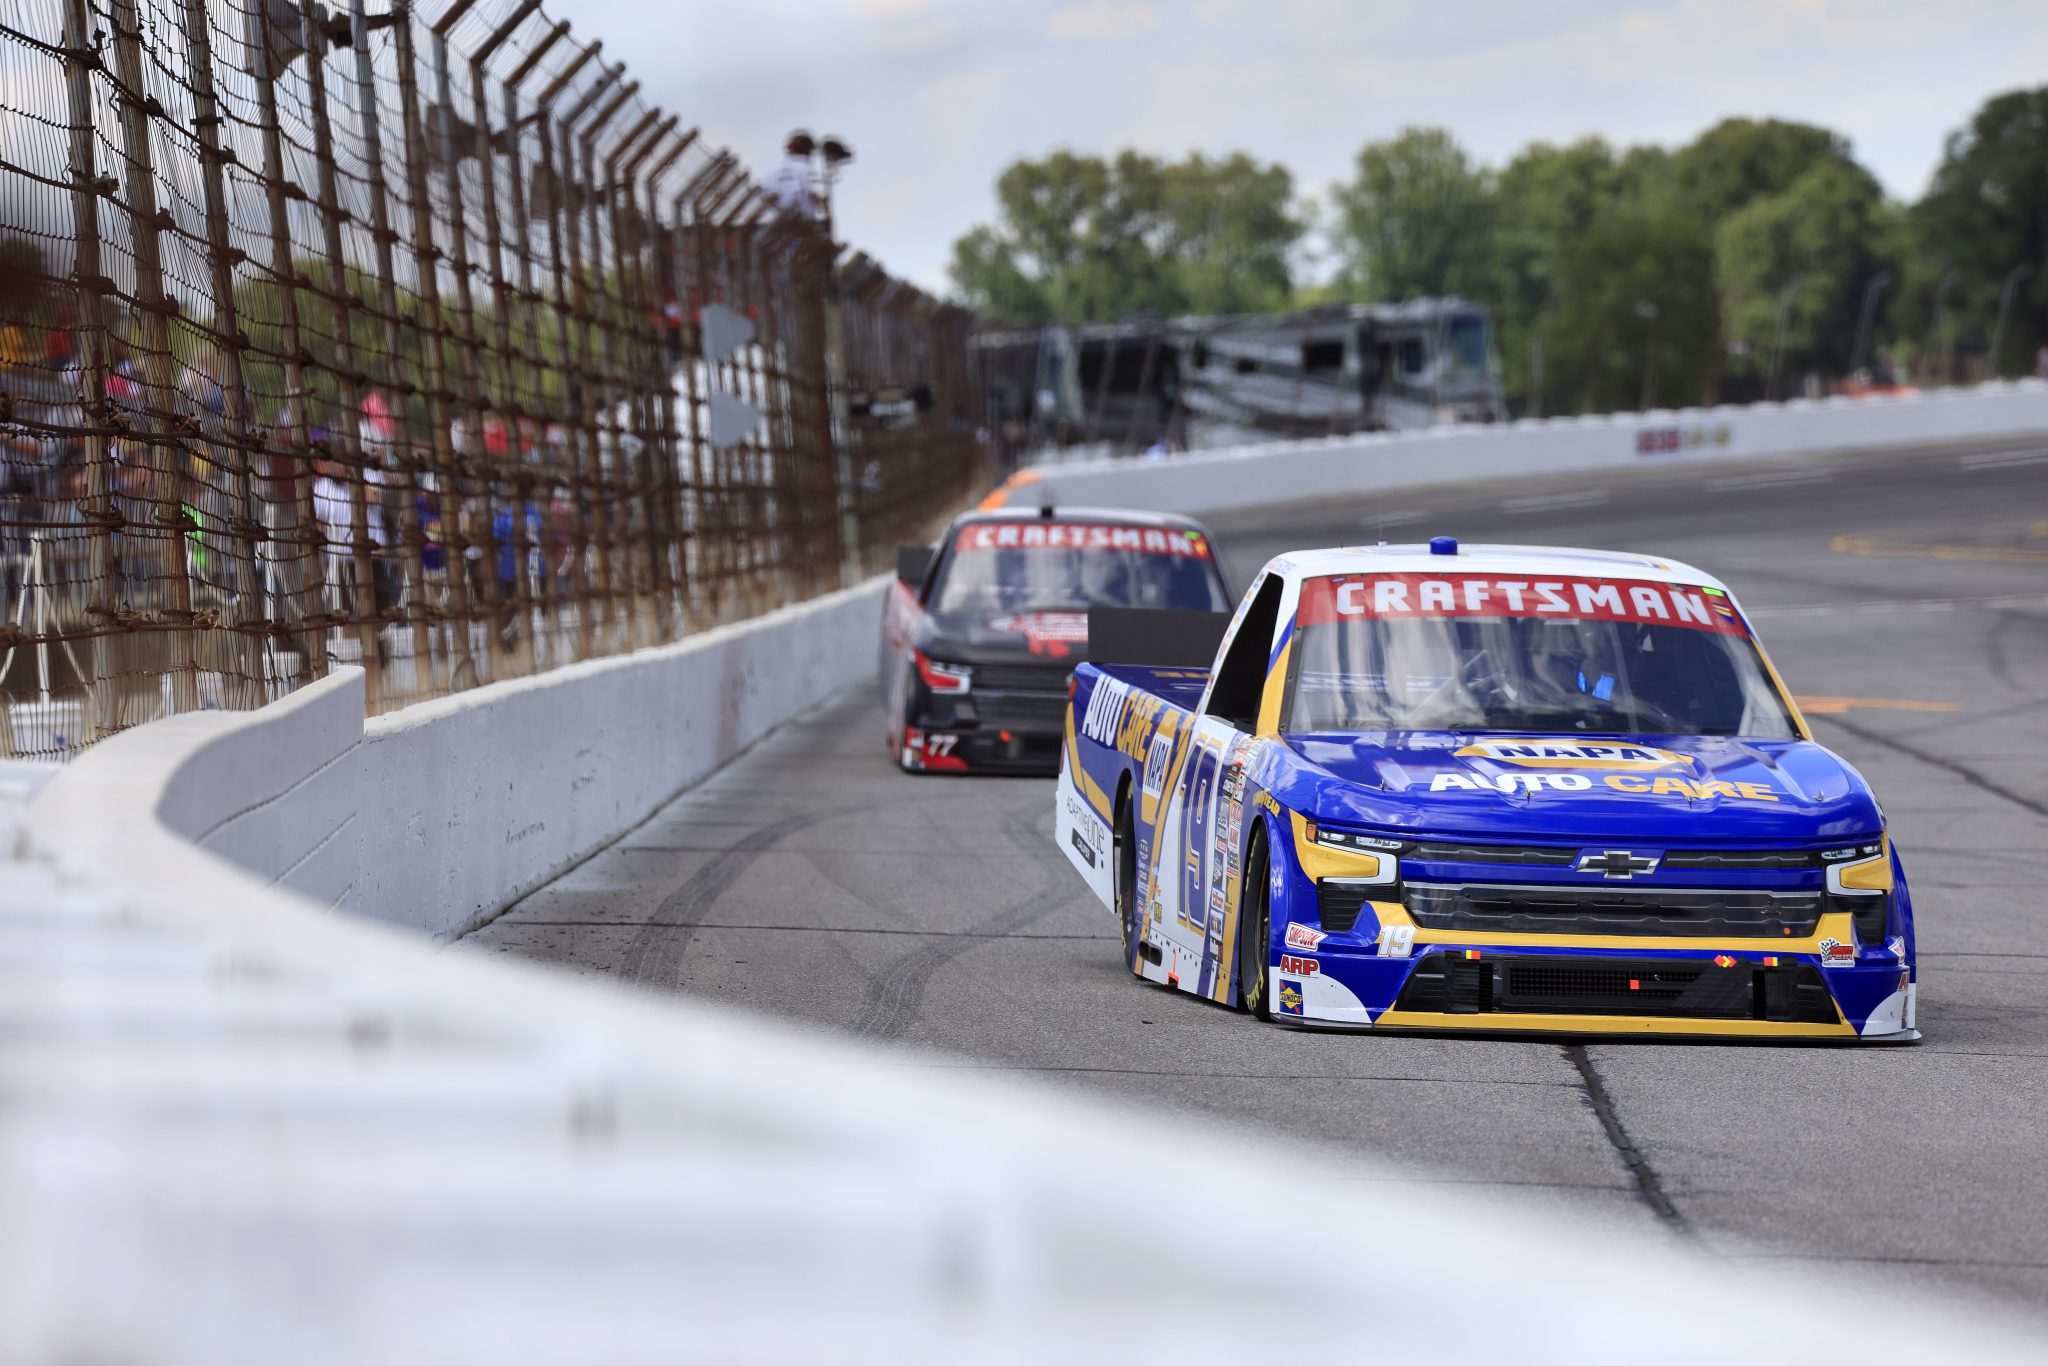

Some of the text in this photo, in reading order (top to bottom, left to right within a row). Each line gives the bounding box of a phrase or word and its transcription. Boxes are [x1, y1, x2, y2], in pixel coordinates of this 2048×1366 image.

[977, 525, 1193, 555] CRAFTSMAN
[1337, 581, 1713, 626] CRAFTSMAN
[1082, 672, 1163, 763] AUTO CARE
[928, 734, 958, 757] 77
[1497, 744, 1659, 762] NAPA
[1144, 739, 1169, 792] NAPA
[1430, 772, 1780, 802] AUTO CARE
[1177, 740, 1221, 937] 19
[1288, 926, 1319, 946] SIMPSON
[1377, 925, 1417, 957] 19
[1281, 955, 1319, 975] ARP
[1280, 992, 1303, 1004] SUNOCO
